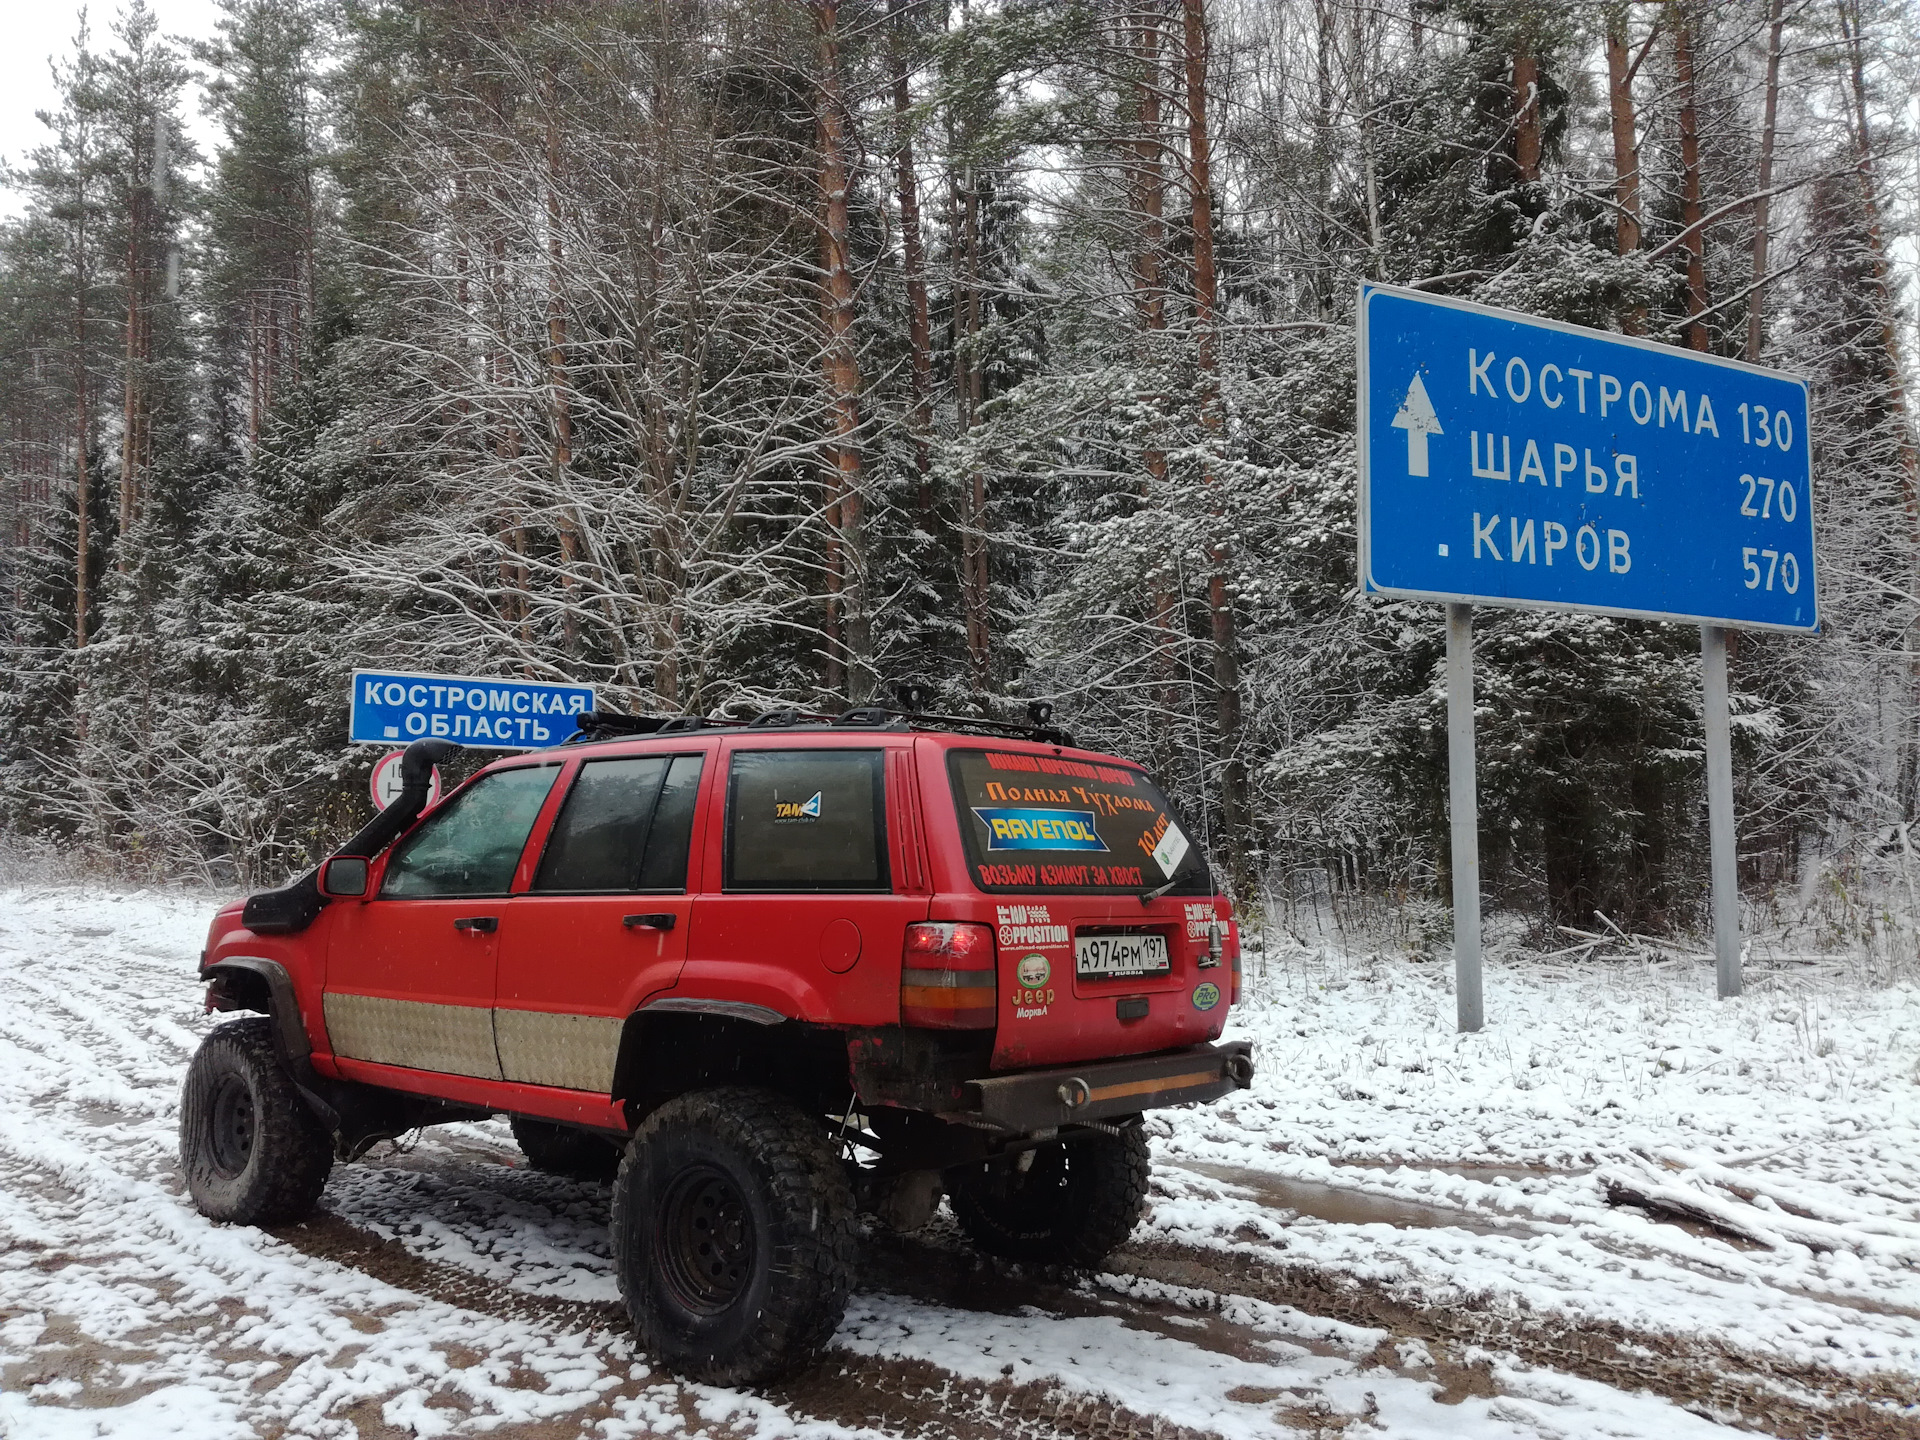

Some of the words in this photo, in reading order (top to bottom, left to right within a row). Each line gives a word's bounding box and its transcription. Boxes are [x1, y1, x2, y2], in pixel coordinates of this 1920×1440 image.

[1469, 348, 1720, 438] КОСТРОМА
[1737, 402, 1793, 453] 130
[1470, 430, 1639, 499] ШАРЬЯ
[1740, 473, 1797, 523] 270
[1472, 512, 1632, 575] КИРОВ
[1742, 547, 1799, 595] 570
[364, 681, 585, 716] КОСТРОМСКАЯ
[405, 712, 550, 741] ОБЛАСТЬ
[990, 819, 1096, 841] RAVENOL
[1138, 830, 1156, 857] 10
[978, 864, 1036, 886] ВОЗЬМУ
[1040, 865, 1090, 886] АЗИМУТ
[1091, 866, 1109, 886] ЗА
[1108, 866, 1143, 886] ХВОСТ
[1143, 938, 1162, 959] 197
[1012, 989, 1055, 1006] Jeep
